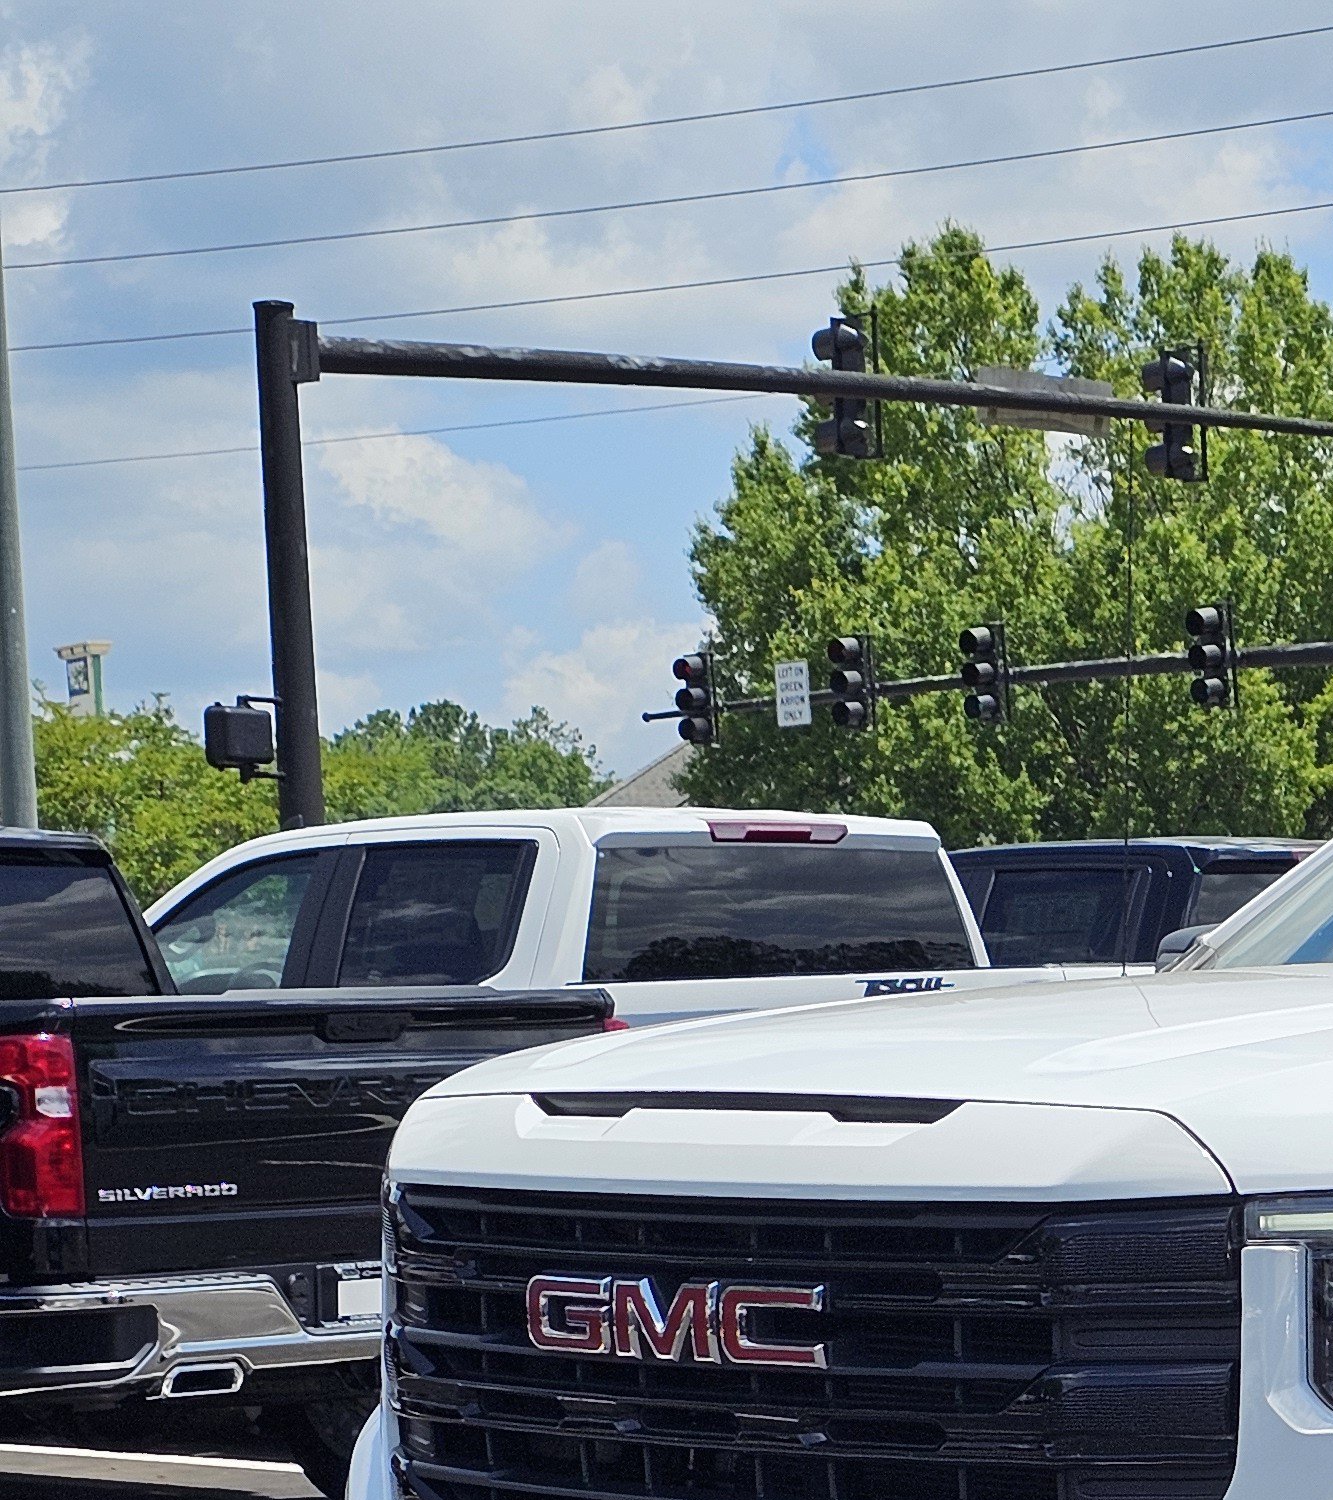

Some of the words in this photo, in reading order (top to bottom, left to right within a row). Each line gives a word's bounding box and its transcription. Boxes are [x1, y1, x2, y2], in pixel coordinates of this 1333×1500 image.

[778, 666, 793, 678] LEFT
[795, 666, 804, 676] ON
[780, 682, 804, 692] GREEN
[780, 695, 805, 706] ARROW
[783, 710, 803, 721] ONLY
[98, 1183, 238, 1202] SILVERADO
[526, 1274, 828, 1369] GMC
